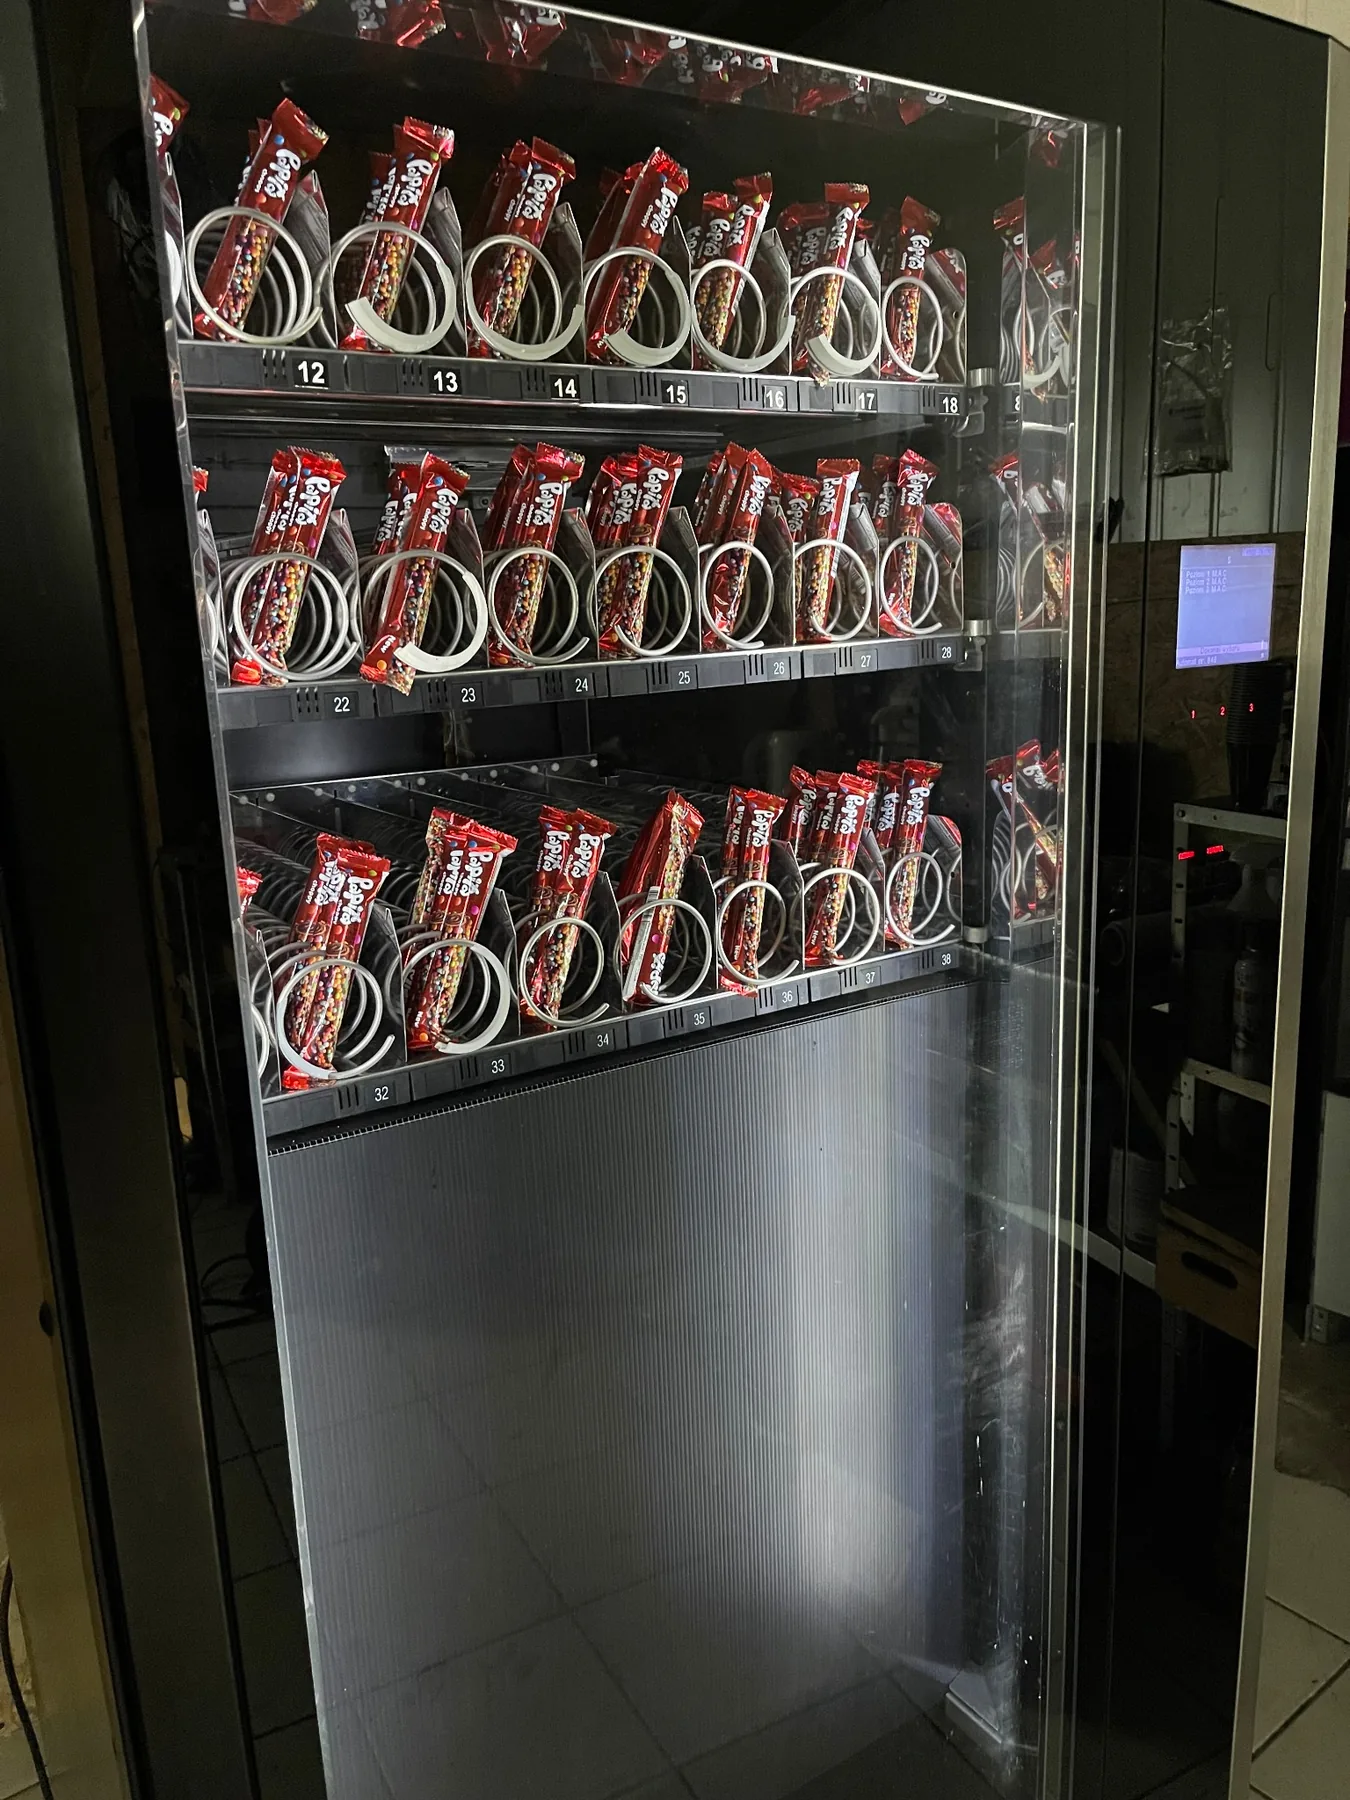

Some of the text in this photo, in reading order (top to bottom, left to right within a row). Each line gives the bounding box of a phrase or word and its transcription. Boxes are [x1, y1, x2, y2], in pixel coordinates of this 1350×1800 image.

[264, 149, 301, 200] Papita
[399, 160, 433, 206] Papita
[522, 173, 557, 220] Papita
[651, 187, 678, 237] Papita
[829, 207, 854, 250] Papita
[908, 235, 930, 270] Papita
[298, 362, 325, 383] 12
[434, 371, 458, 392] 13
[554, 379, 577, 397] 14
[666, 386, 687, 404] 15
[766, 391, 784, 408] 16
[858, 393, 875, 409] 17
[942, 396, 958, 414] 18
[641, 467, 669, 510] Papita
[296, 477, 330, 526] Papita
[533, 482, 563, 526] Papita
[429, 488, 458, 534] Papita
[861, 655, 871, 668] 27
[942, 647, 951, 659] 28
[773, 662, 784, 675] 26
[575, 679, 588, 692] 24
[678, 672, 691, 684] 25
[461, 688, 476, 702] 23
[1191, 710, 1196, 719] 1
[1220, 706, 1225, 715] 2
[1249, 703, 1254, 712] 3
[840, 794, 864, 834] Papita
[907, 786, 930, 824] Papita
[752, 809, 774, 847] Papita
[543, 831, 570, 873] Papita
[571, 833, 600, 879] Papita
[460, 851, 493, 896] Papita
[340, 876, 373, 926] Papita
[942, 954, 951, 965] 38
[865, 972, 875, 984] 37
[782, 991, 793, 1003] 36
[694, 1012, 705, 1025] 35
[597, 1034, 609, 1047] 34
[491, 1059, 504, 1073] 33
[375, 1086, 389, 1102] 32
